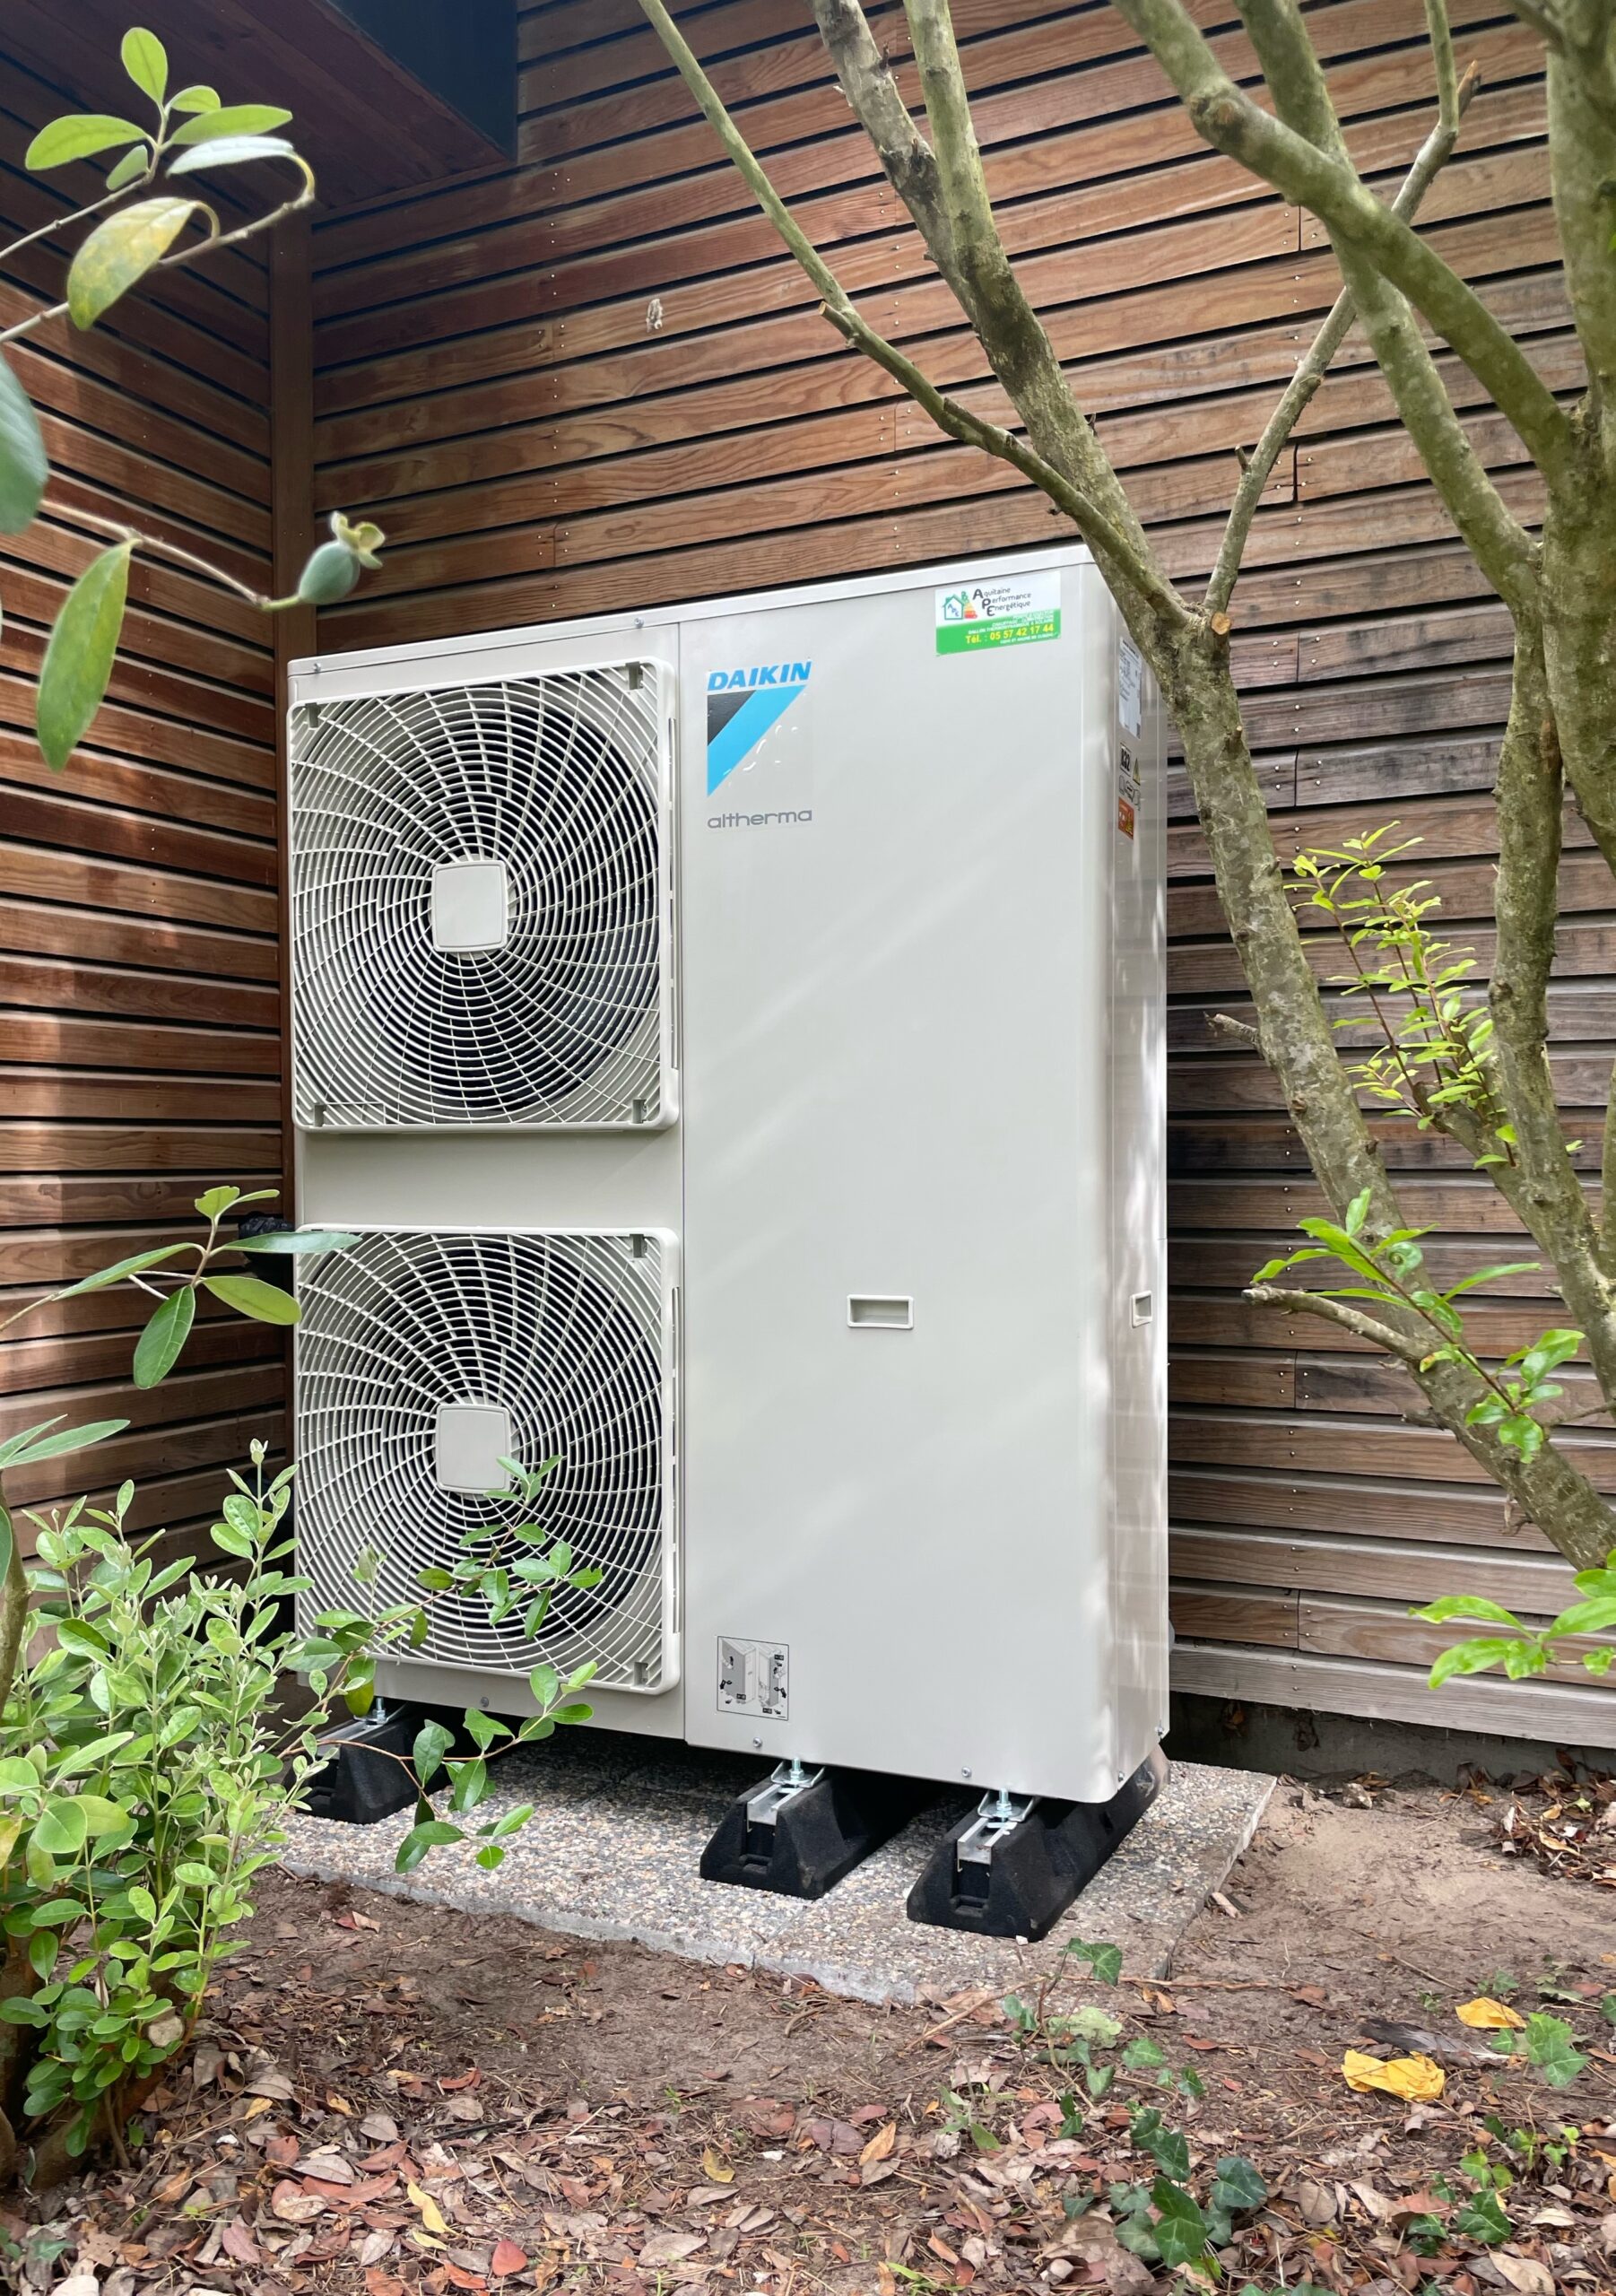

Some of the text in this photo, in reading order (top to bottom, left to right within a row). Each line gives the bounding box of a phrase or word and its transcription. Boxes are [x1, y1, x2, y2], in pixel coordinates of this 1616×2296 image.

[972, 588, 1011, 601] Aquitaine
[982, 593, 1031, 610] Performance
[990, 631, 1001, 640] 05
[1003, 630, 1013, 639] 57
[1016, 627, 1028, 637] 42
[1030, 625, 1040, 635] 17
[1043, 623, 1054, 632] 44
[707, 661, 812, 691] DAIKIN
[707, 810, 812, 829] altherma
